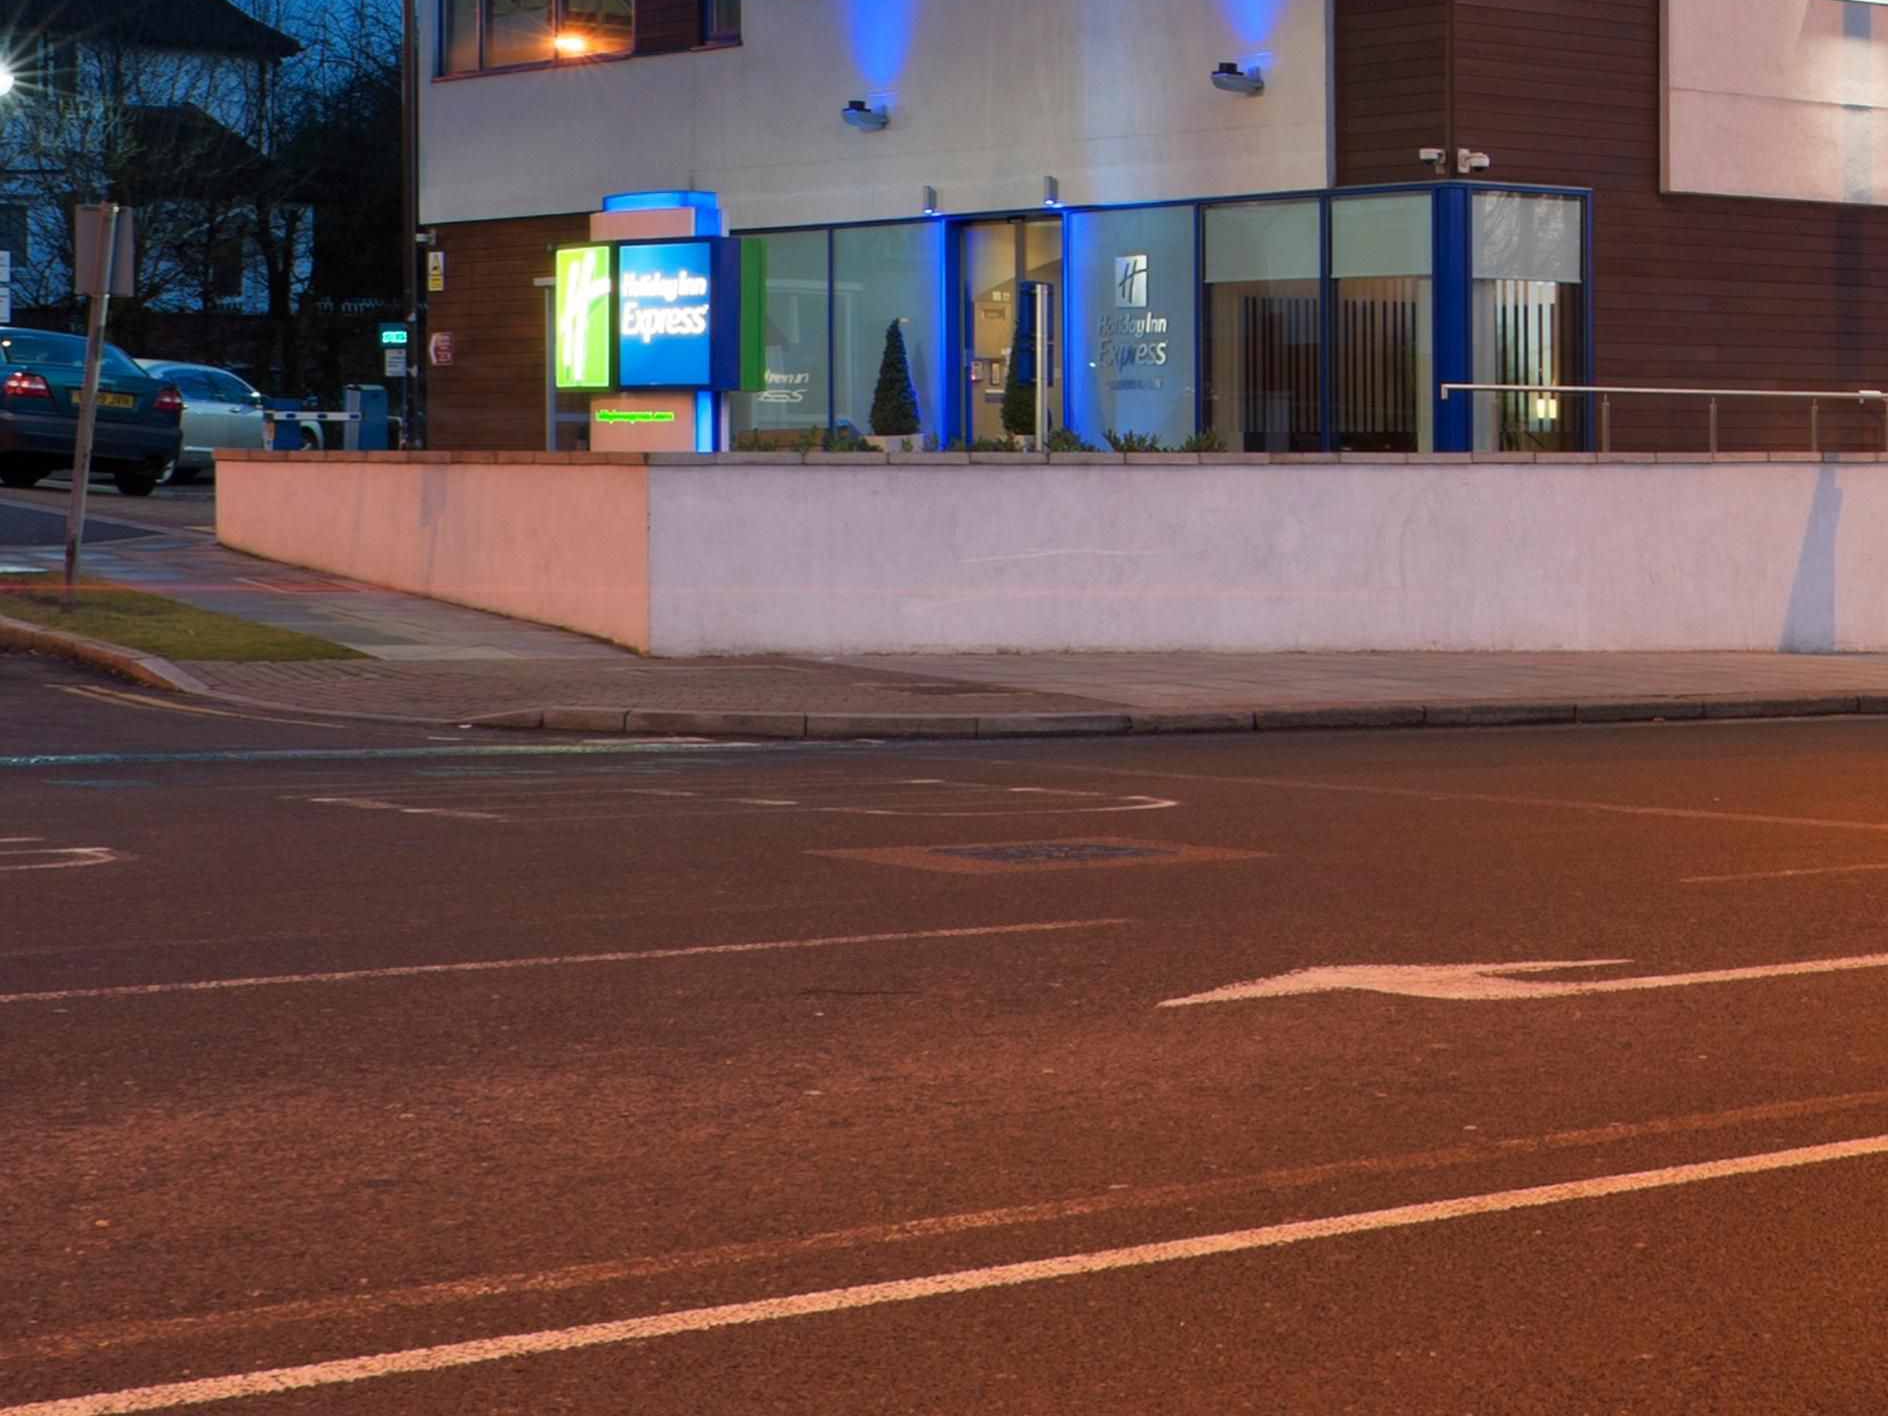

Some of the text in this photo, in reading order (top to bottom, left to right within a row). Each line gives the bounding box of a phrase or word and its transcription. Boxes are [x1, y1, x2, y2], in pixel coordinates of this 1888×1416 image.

[622, 270, 707, 302] Holiday Inn
[622, 301, 707, 344] Express
[1098, 311, 1167, 338] Holiday Inn
[1099, 339, 1168, 373] Express
